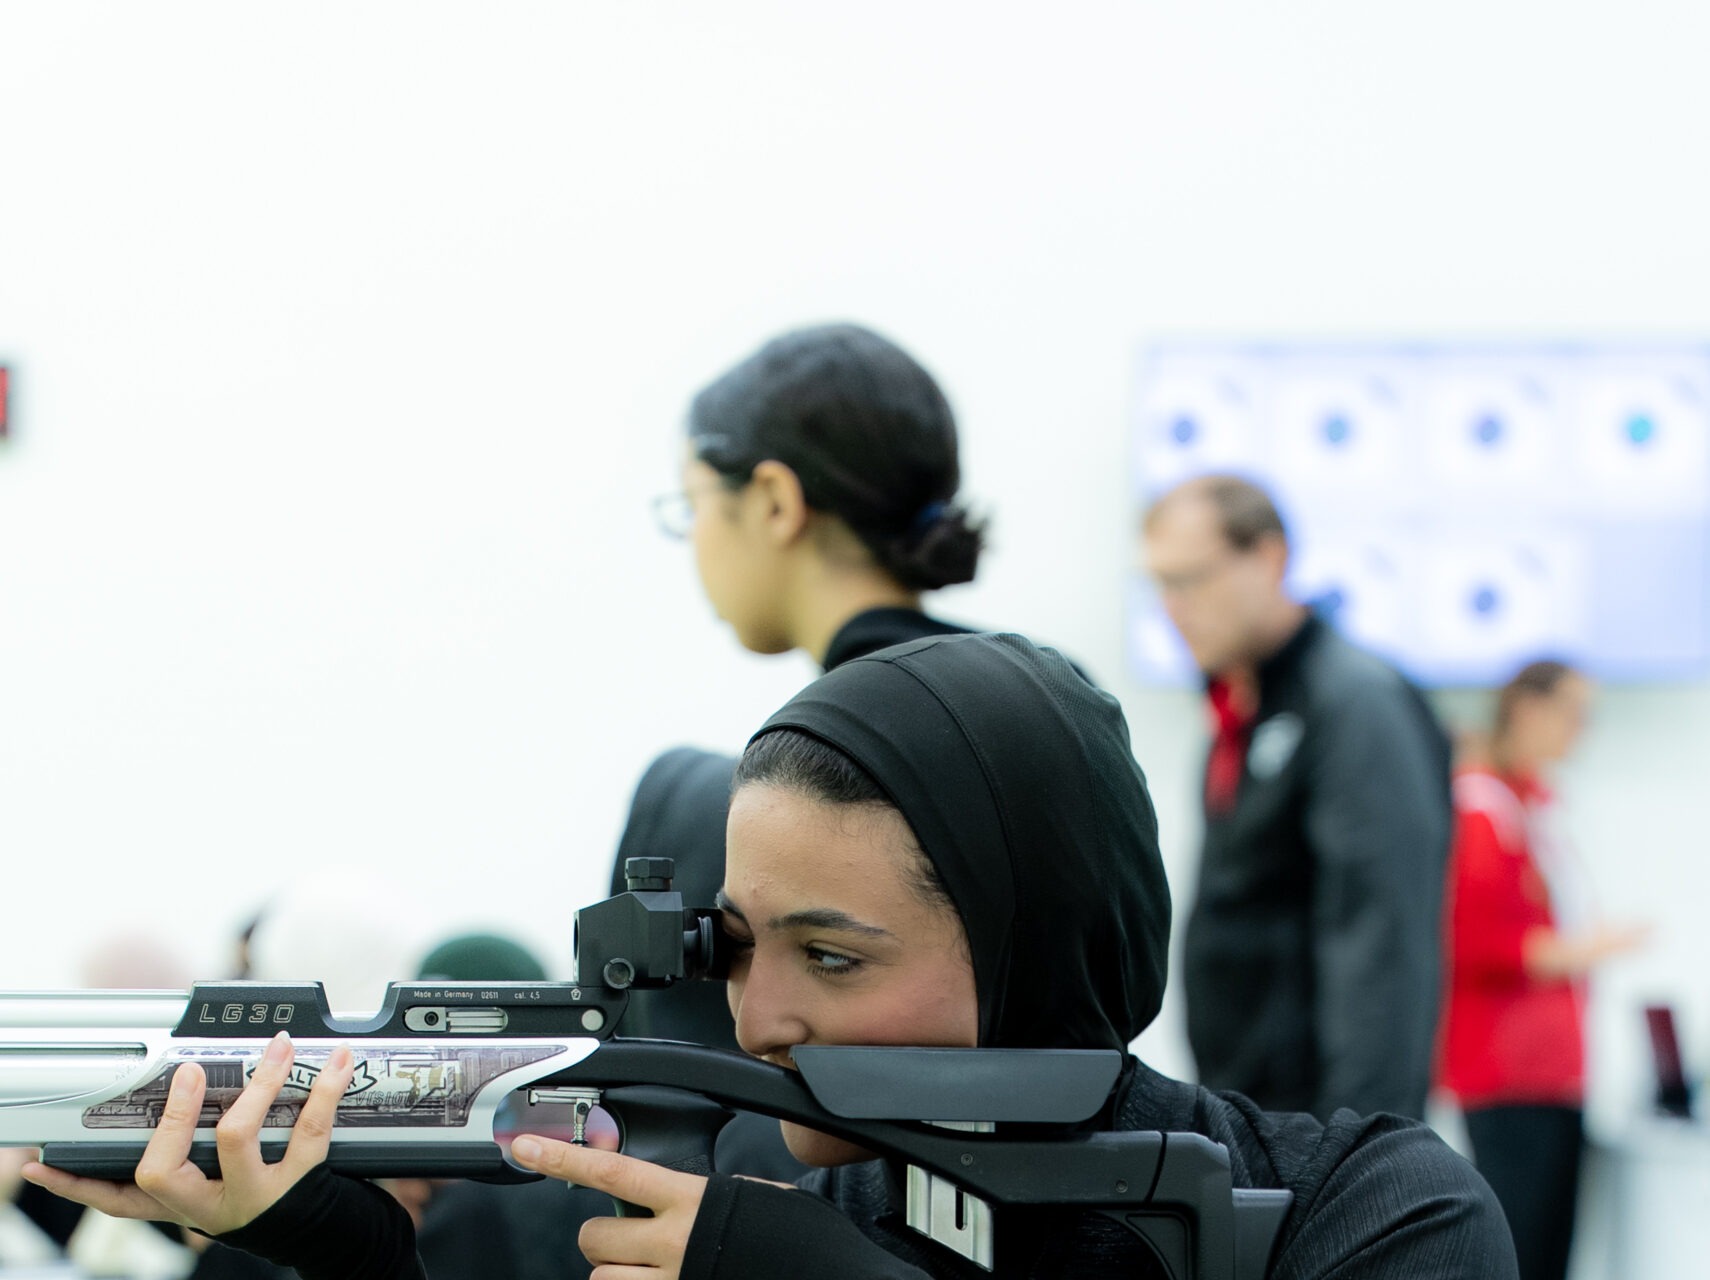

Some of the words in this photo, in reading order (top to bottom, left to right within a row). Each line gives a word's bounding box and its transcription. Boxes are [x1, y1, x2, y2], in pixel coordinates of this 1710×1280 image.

[413, 990, 432, 999] Made
[444, 990, 474, 1000] Germany
[514, 991, 526, 999] cal.
[530, 990, 540, 1000] 4,5
[199, 1003, 295, 1023] LG30
[286, 1068, 358, 1091] ALTR
